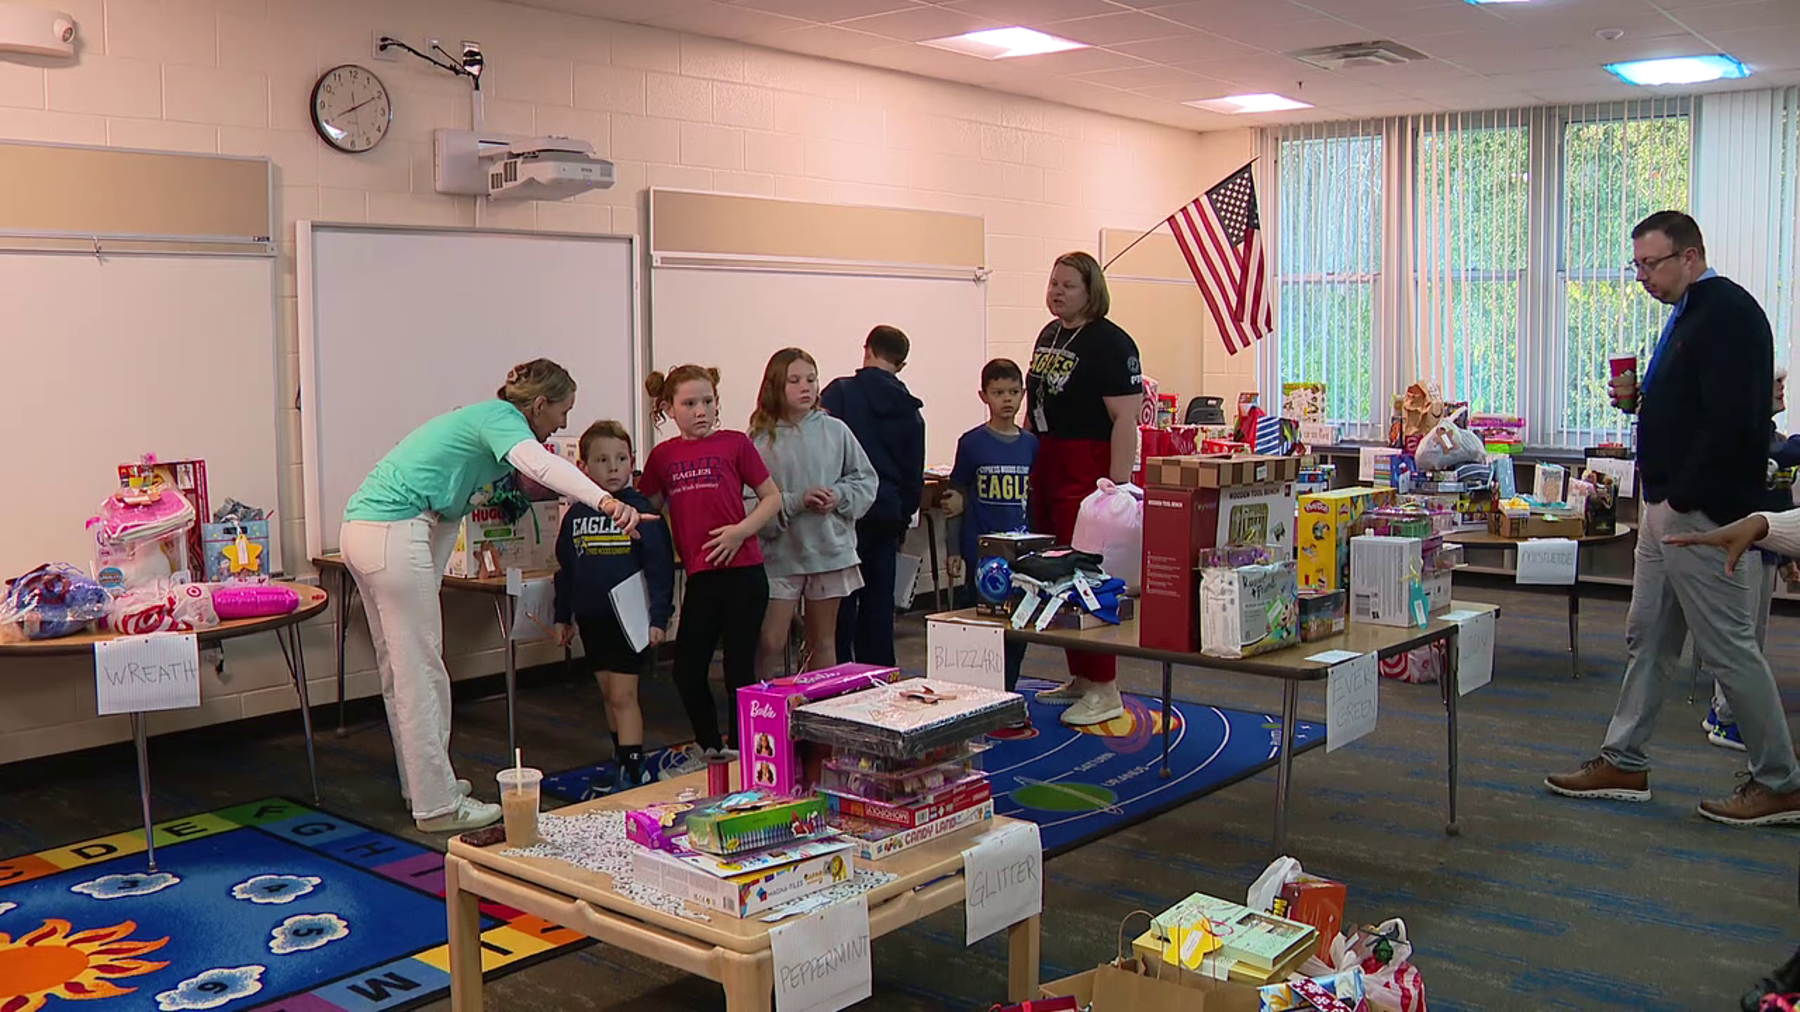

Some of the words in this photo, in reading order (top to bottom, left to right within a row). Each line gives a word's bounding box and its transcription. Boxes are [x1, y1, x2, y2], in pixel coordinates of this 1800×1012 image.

[333, 73, 341, 81] 11
[349, 70, 358, 79] 12
[323, 84, 332, 94] 10
[376, 90, 383, 100] 2
[319, 101, 326, 110] 9
[380, 107, 386, 117] 3
[349, 140, 356, 149] 6
[365, 137, 372, 146] 5
[672, 468, 711, 481] EAGLES
[934, 646, 1003, 674] BLIZZARD
[104, 660, 197, 687] WREATH
[750, 700, 777, 719] Barbie
[1336, 699, 1376, 728] GREEN
[866, 804, 910, 824] MONOPOLY
[162, 821, 208, 838] E
[905, 825, 935, 846] CANDY
[934, 816, 957, 834] LAND
[70, 843, 119, 860] D
[969, 855, 1038, 908] GLITTER
[779, 934, 869, 994] PEPPERMINT
